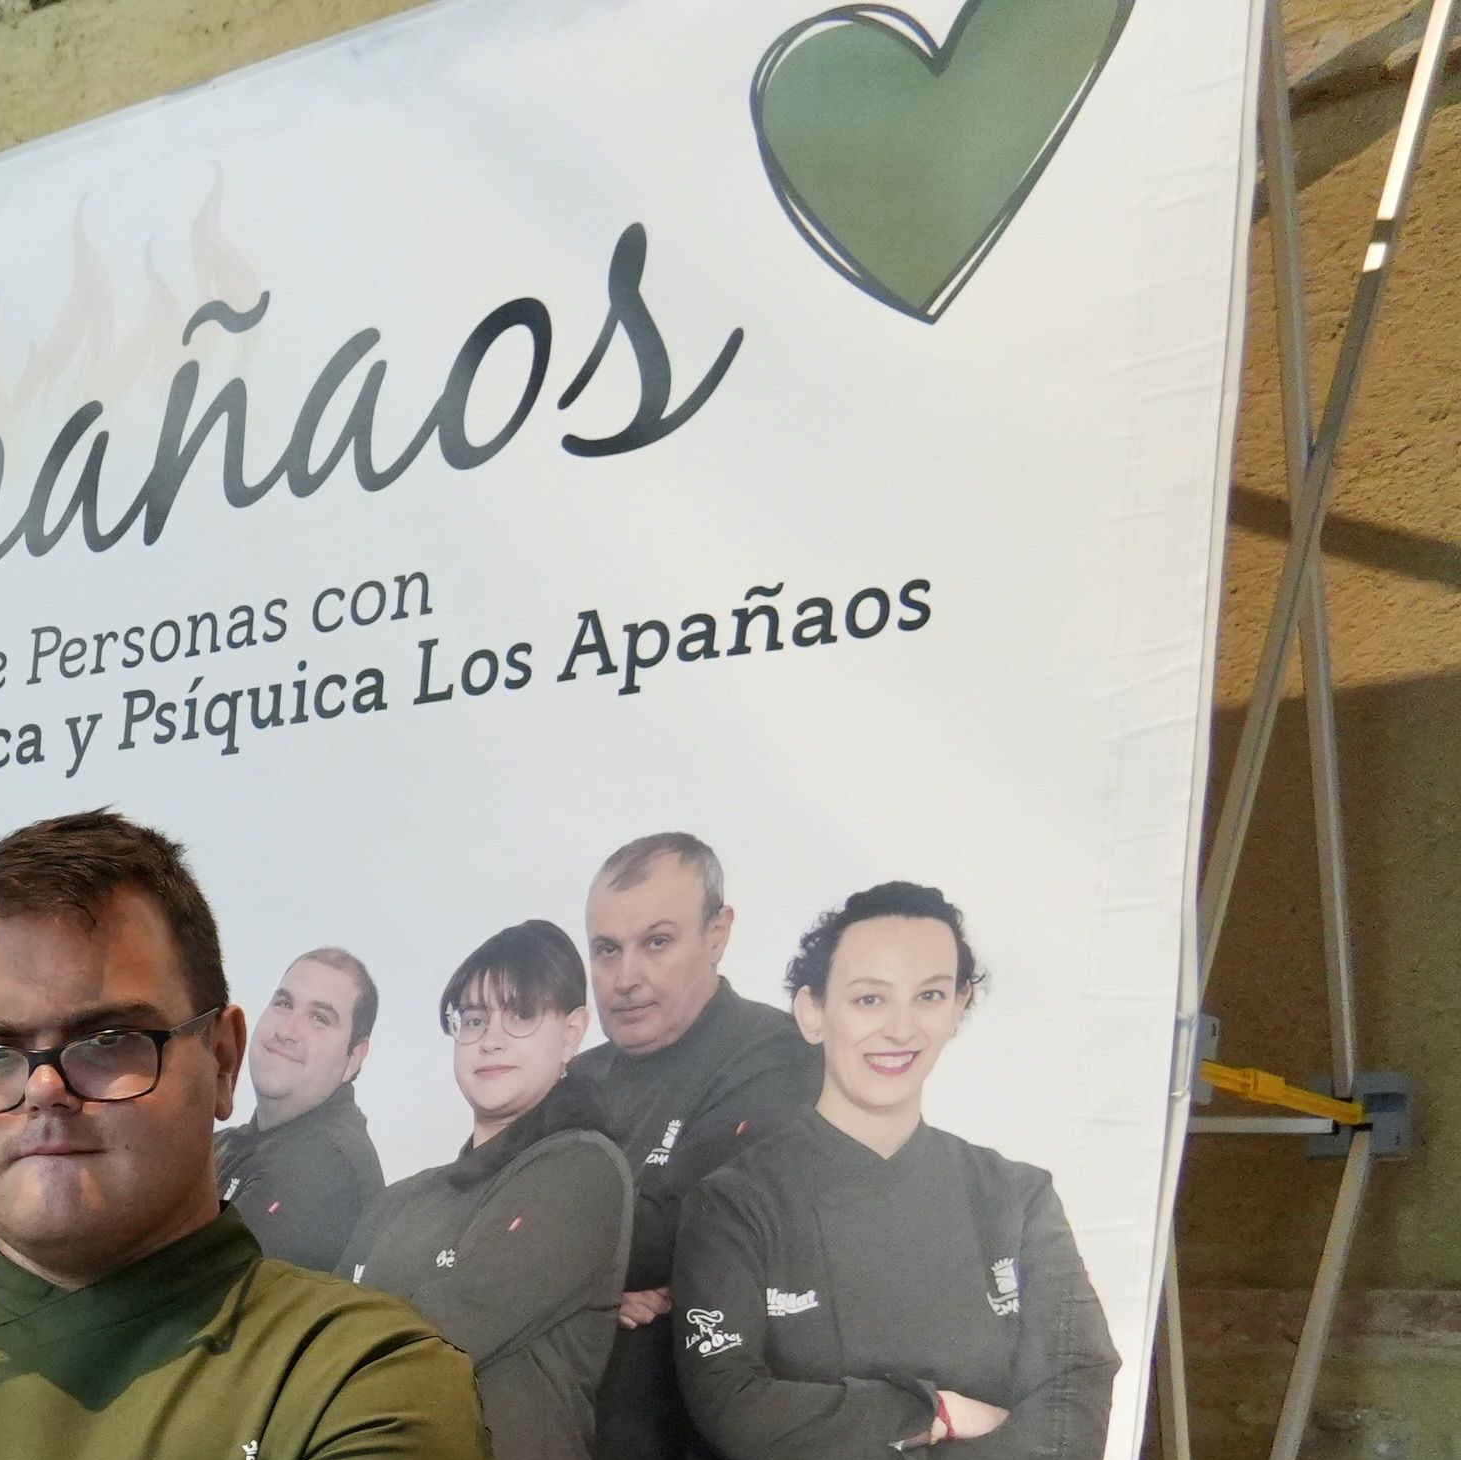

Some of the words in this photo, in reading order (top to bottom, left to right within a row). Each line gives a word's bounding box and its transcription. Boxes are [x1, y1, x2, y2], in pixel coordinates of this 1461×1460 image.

[25, 597, 287, 686] Personas
[312, 570, 435, 633] con
[64, 711, 102, 777] y
[117, 660, 388, 757] Psíquica
[412, 640, 533, 705] Los
[557, 577, 933, 697] Apañaos
